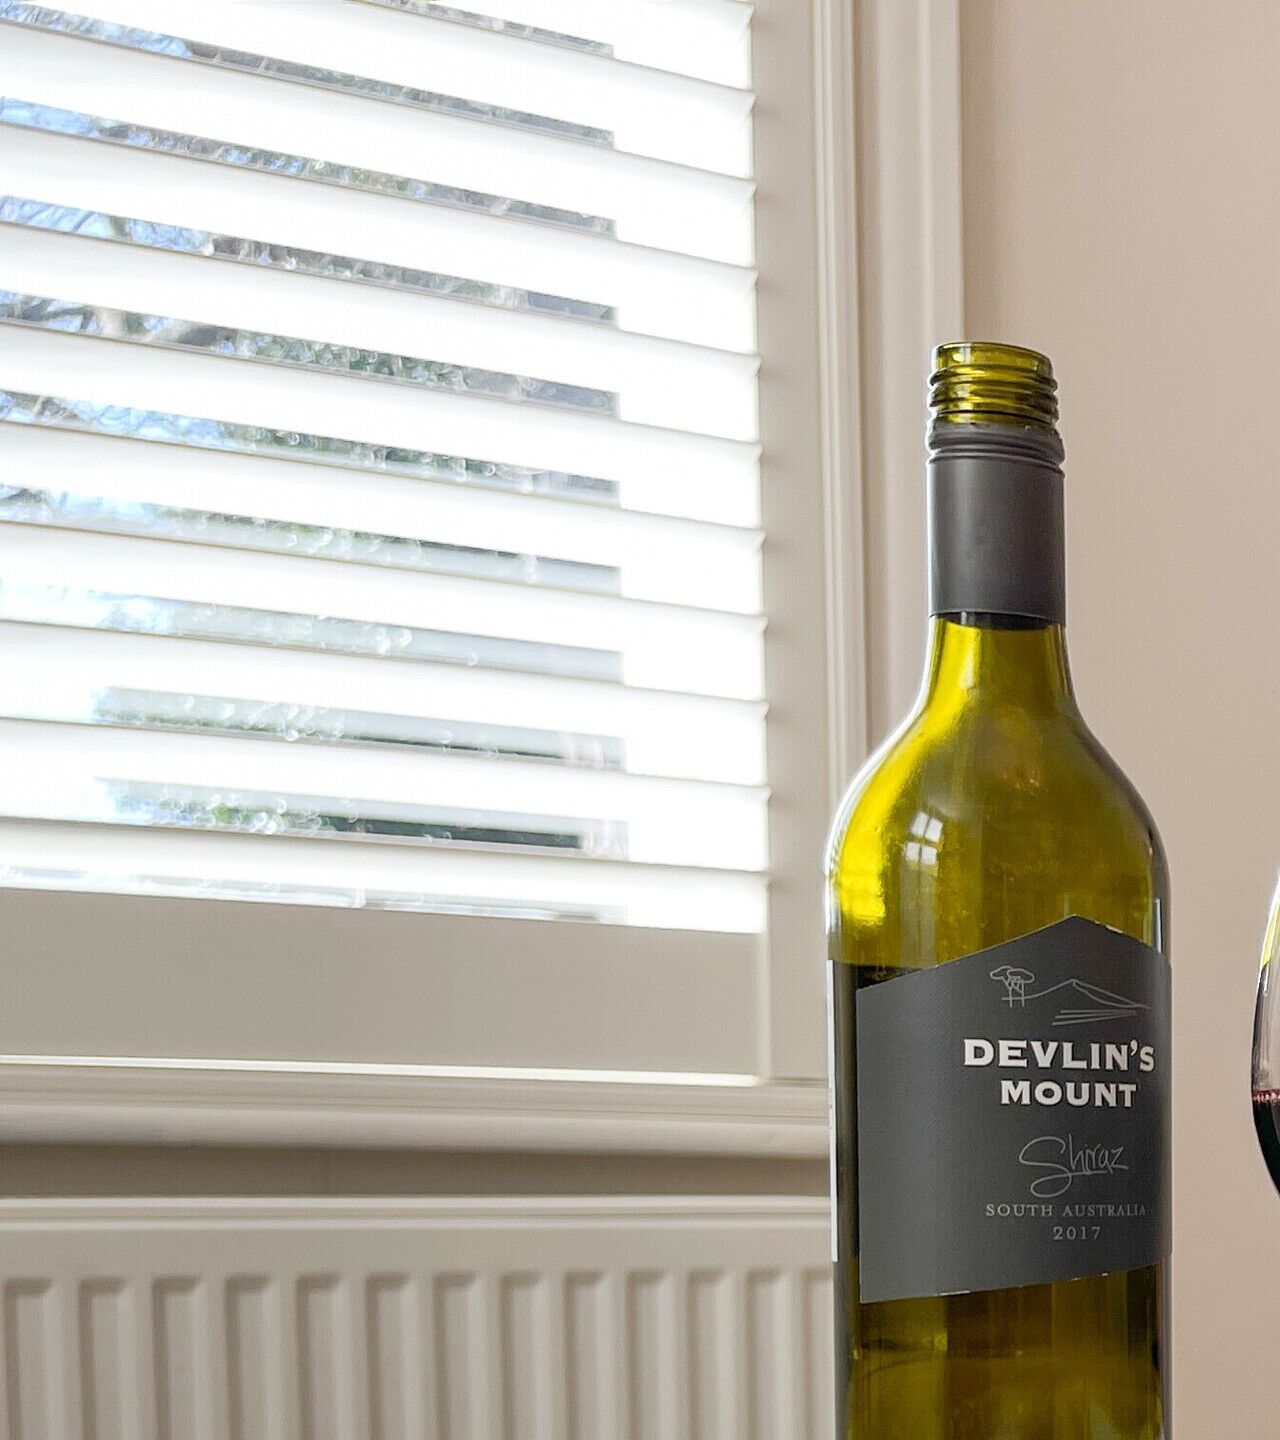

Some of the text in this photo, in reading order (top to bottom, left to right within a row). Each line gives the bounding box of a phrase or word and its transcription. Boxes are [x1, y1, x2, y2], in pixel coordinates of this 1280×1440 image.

[964, 1038, 1155, 1072] DEVLIN'S
[1001, 1080, 1137, 1107] MOUNT
[1019, 1133, 1129, 1197] Shiraz
[986, 1203, 1146, 1217] SOUTH AUSTRALIA
[1052, 1226, 1101, 1240] 2017
